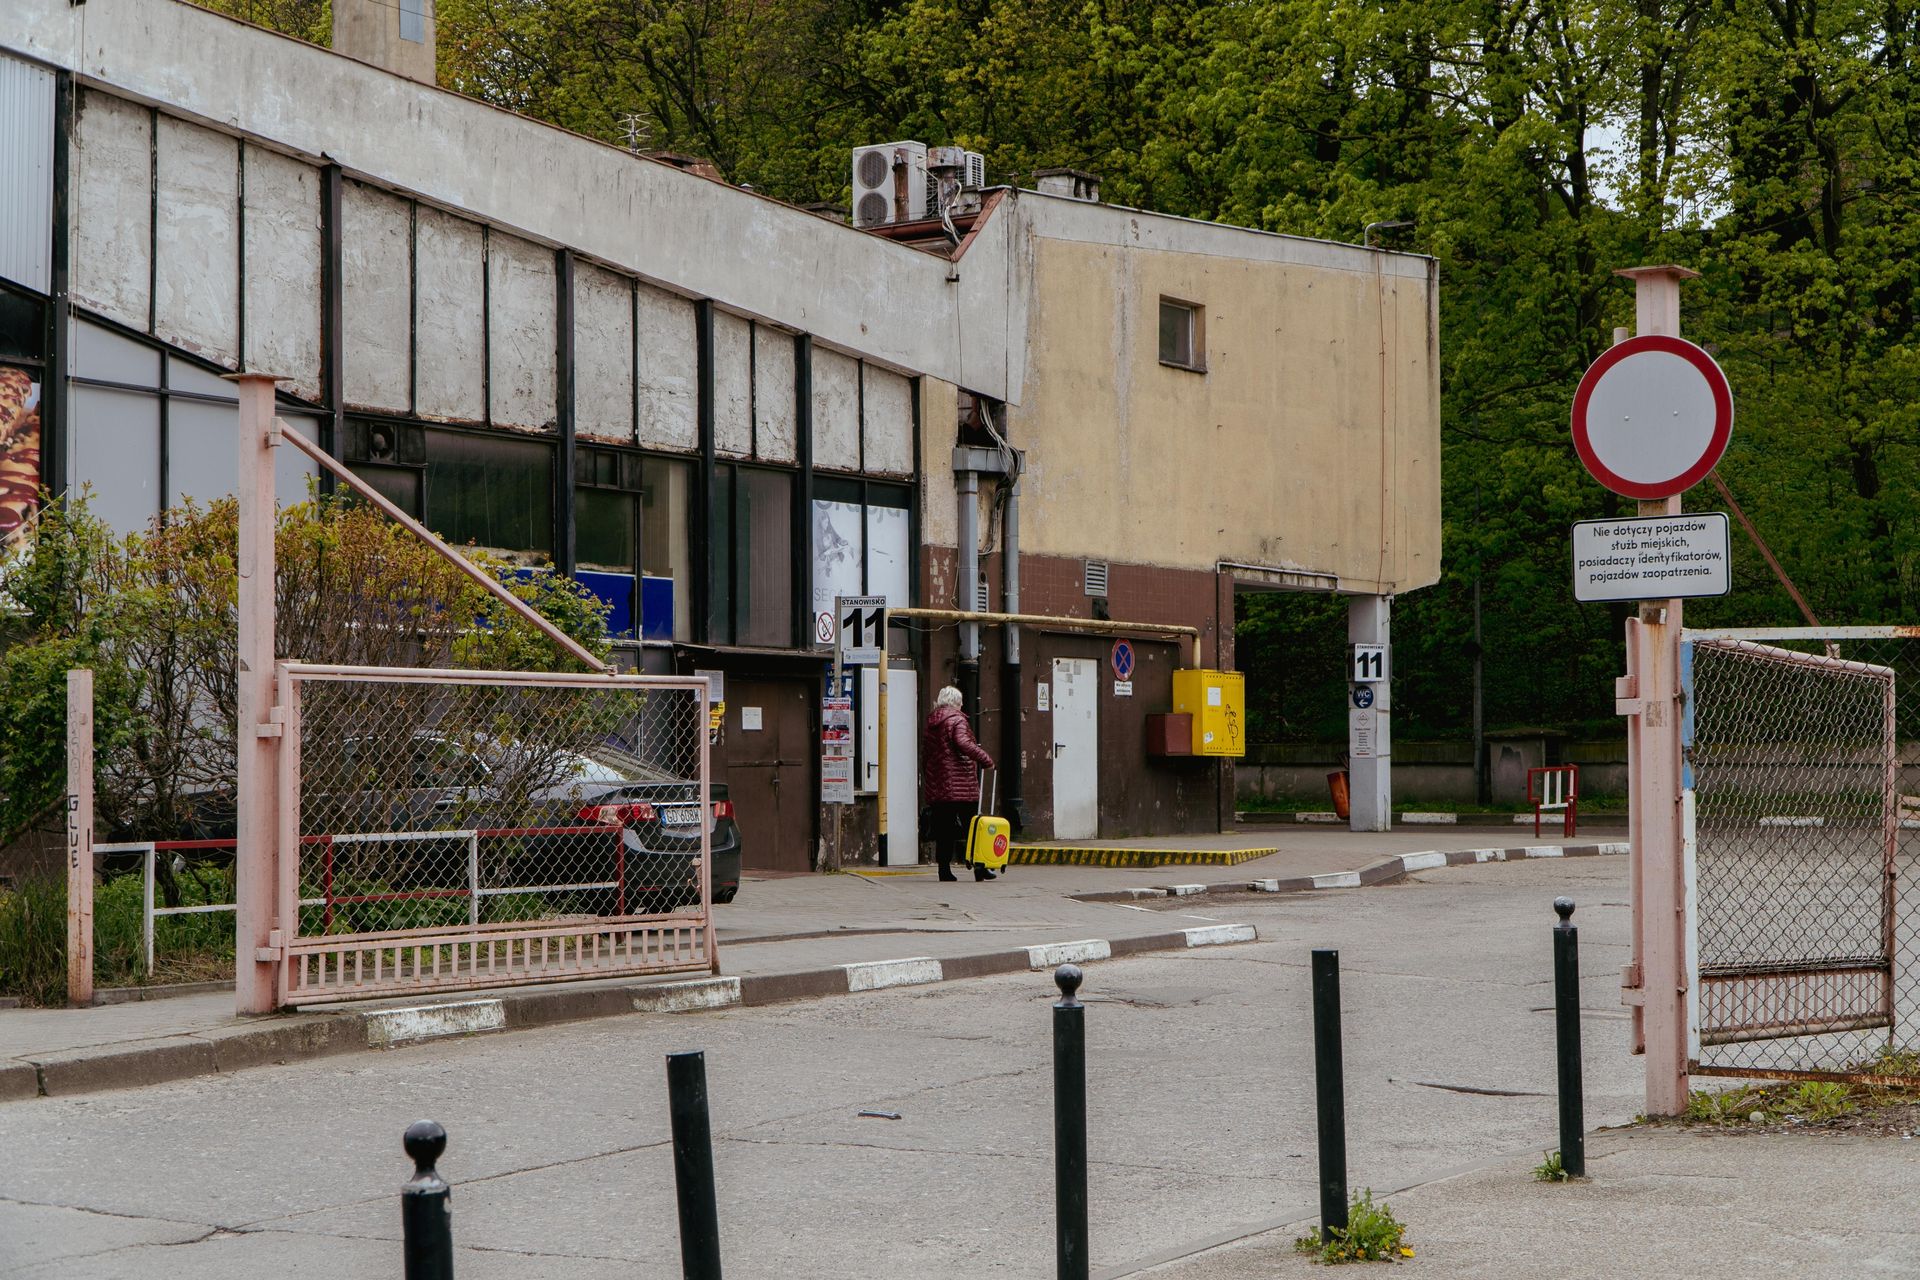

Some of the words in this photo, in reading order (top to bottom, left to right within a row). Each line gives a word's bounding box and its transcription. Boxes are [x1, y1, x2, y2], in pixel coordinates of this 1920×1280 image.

[1593, 527, 1610, 537] Nie
[1613, 525, 1652, 537] dotyczy
[1656, 521, 1706, 536] pojazdów
[1611, 540, 1637, 551] służb
[1641, 537, 1689, 551] miejskich,
[1579, 555, 1635, 569] posiadaczy
[1638, 550, 1722, 566] identyfikatorów,
[1590, 568, 1639, 584] pojazdów
[1642, 565, 1712, 580] zaopatrzenia.
[841, 598, 885, 606] STANOWISKO
[843, 607, 884, 650] 11
[1357, 652, 1382, 678] 11
